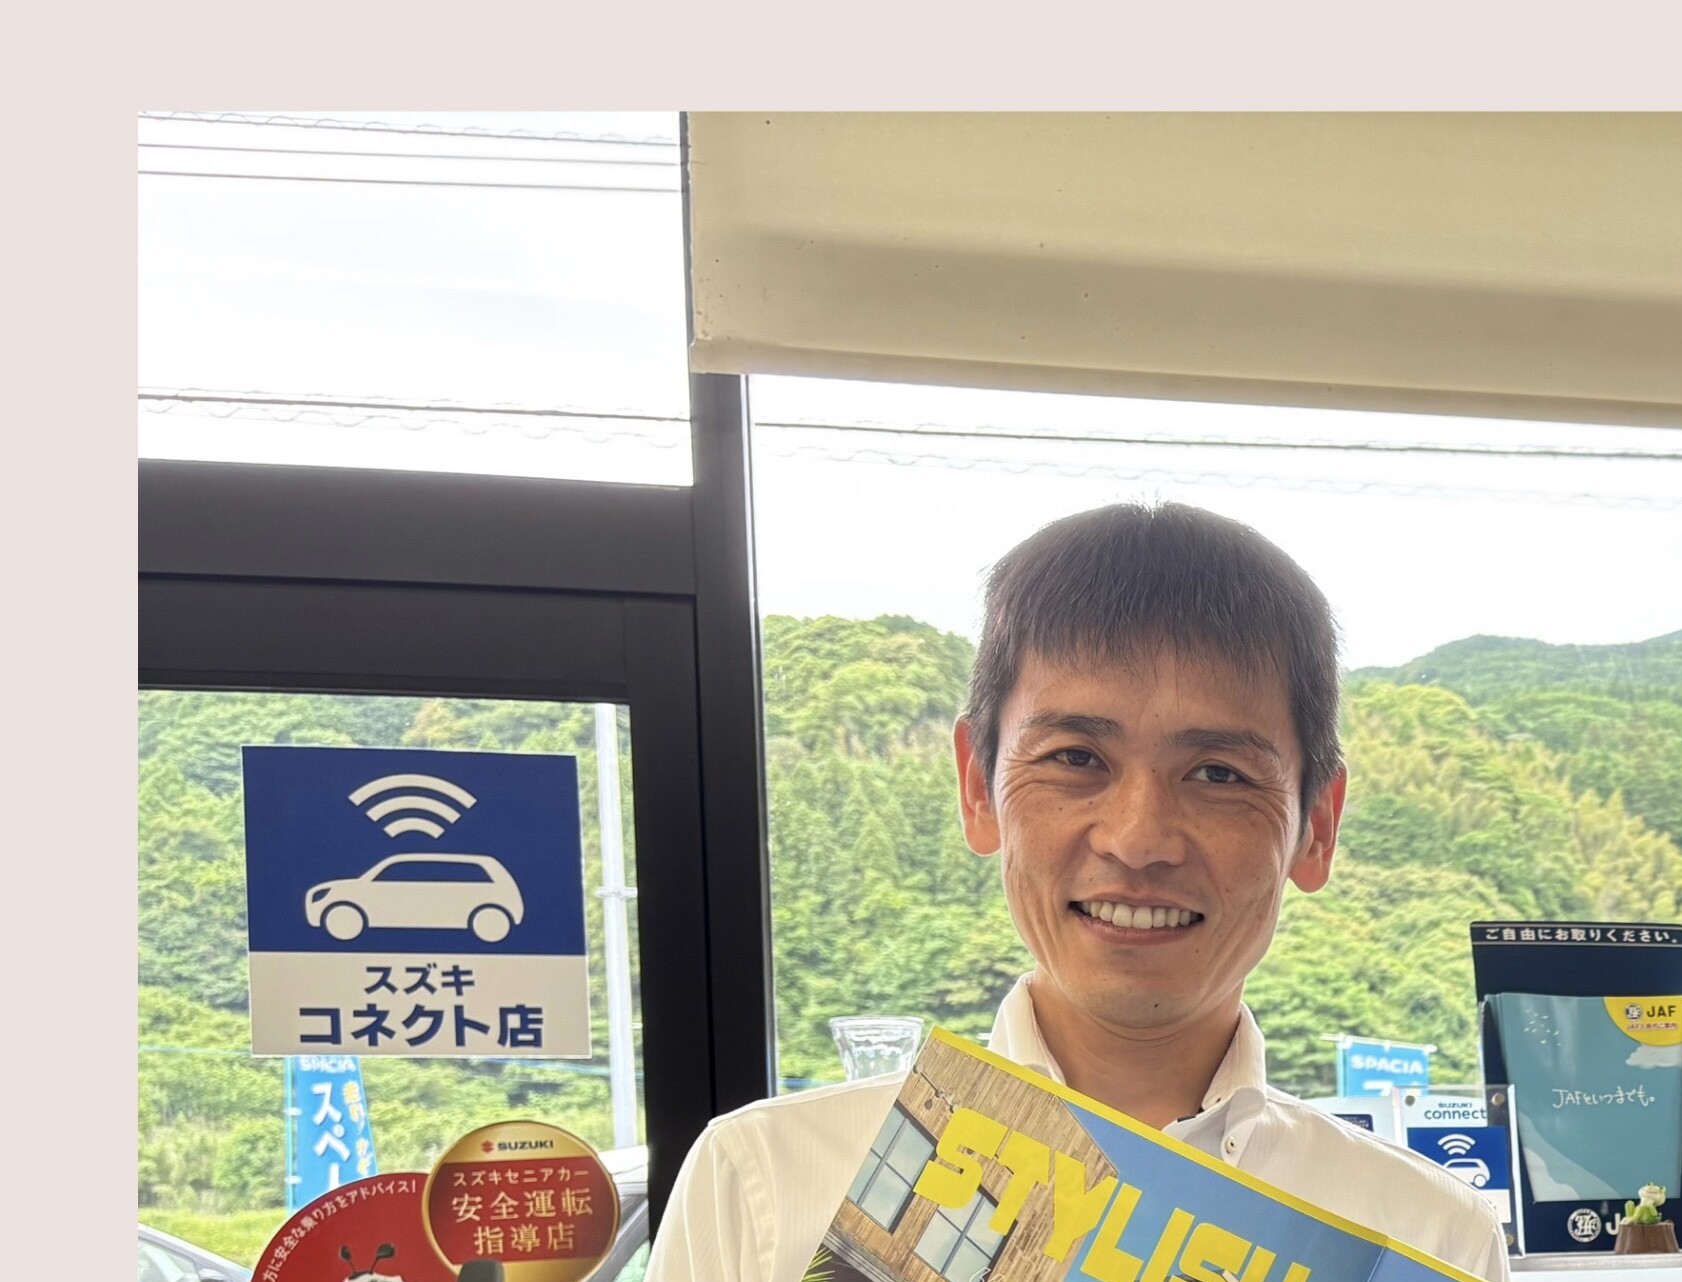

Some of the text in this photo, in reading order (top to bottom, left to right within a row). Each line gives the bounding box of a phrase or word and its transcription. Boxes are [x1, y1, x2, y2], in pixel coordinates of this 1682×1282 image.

[1485, 928, 1679, 944] ご自由にお取りください。
[363, 963, 476, 997] スズキ
[1646, 1005, 1676, 1018] JAF
[299, 1003, 543, 1049] コネクト店
[1351, 1054, 1424, 1075] SPACIA
[1552, 1084, 1656, 1108] JAFといつまでも。
[1424, 1107, 1488, 1120] connect
[497, 1139, 554, 1152] SUZUKI
[453, 1166, 590, 1188] スズキセニアカー
[451, 1187, 594, 1224] 安全運転
[472, 1221, 576, 1256] 指導店
